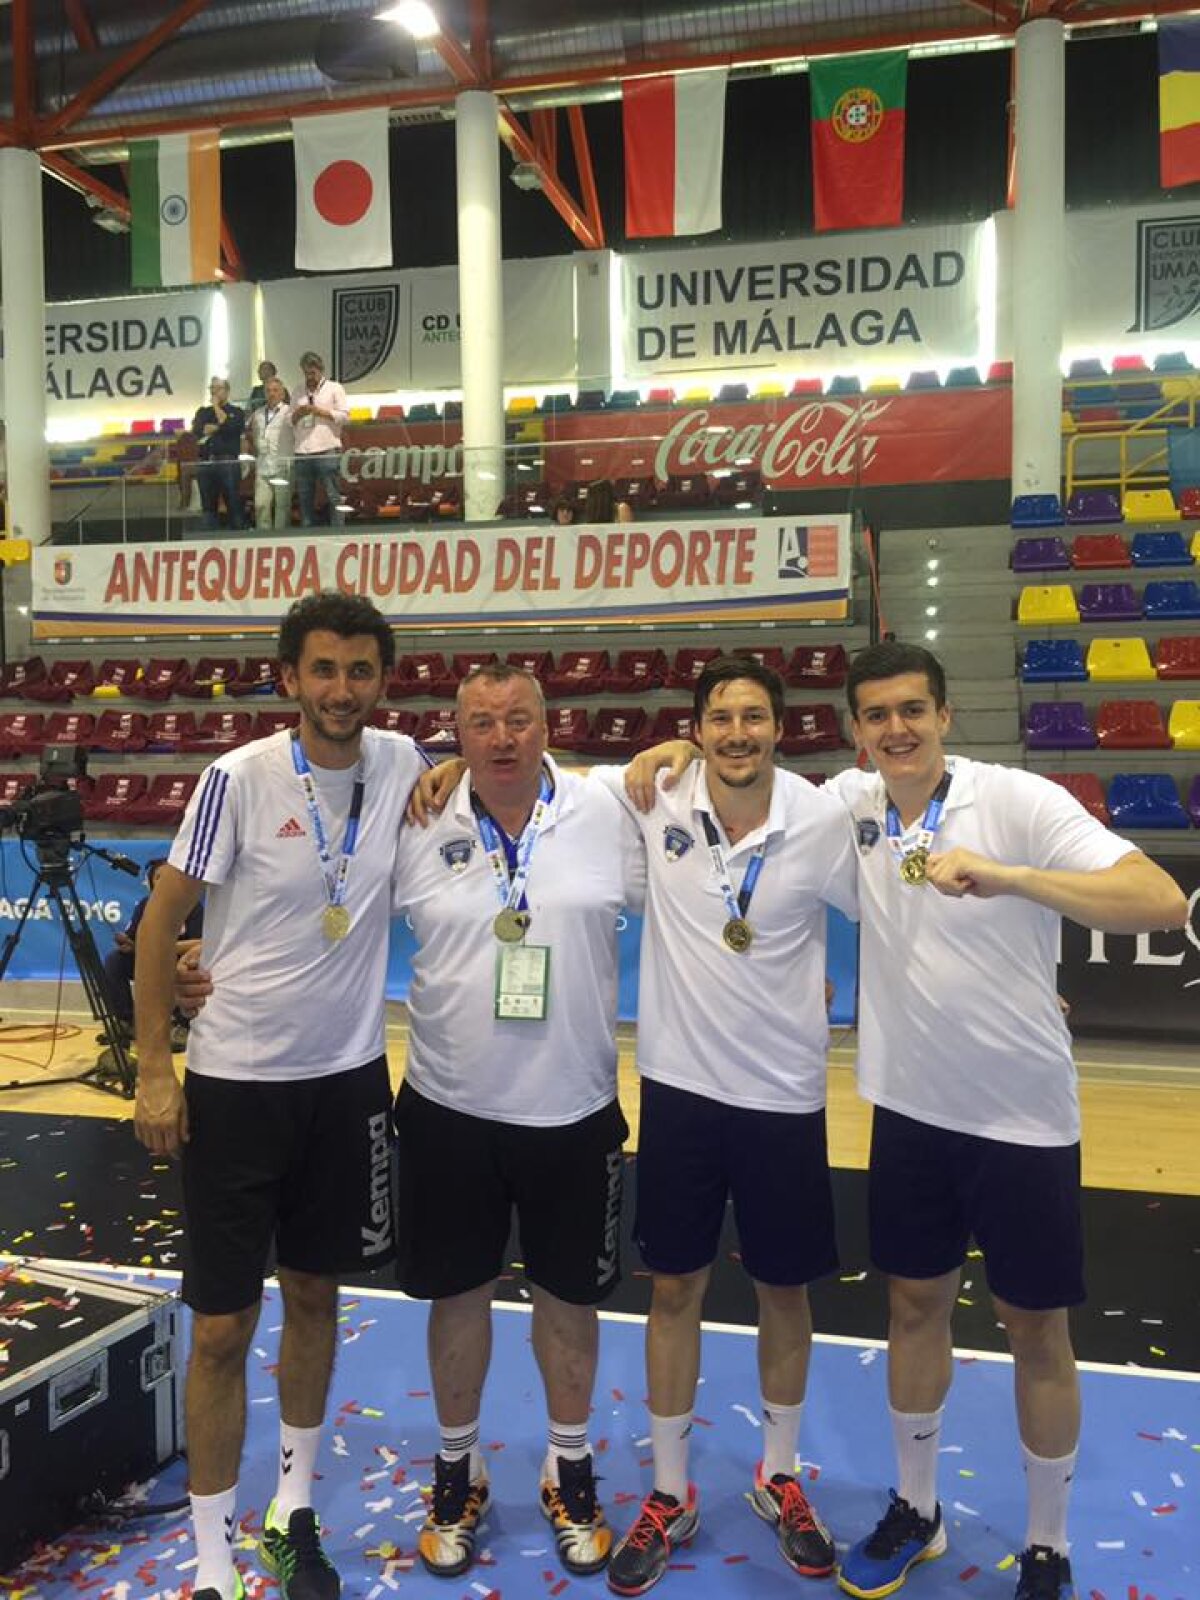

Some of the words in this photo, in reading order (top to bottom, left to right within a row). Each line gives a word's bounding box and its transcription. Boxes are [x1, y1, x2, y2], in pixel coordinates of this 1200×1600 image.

[1153, 230, 1200, 249] CLU
[637, 251, 965, 310] UNIVERSIDAD
[1151, 260, 1199, 280] UMA
[344, 298, 387, 314] CLUB
[422, 315, 451, 331] CD
[45, 315, 202, 356] ERSIDAD
[344, 325, 381, 341] UMA
[637, 323, 697, 361] DE
[713, 307, 922, 356] MÁLAGA
[46, 363, 174, 401] ÁLAGA
[654, 399, 893, 481] Coca-Cola
[104, 546, 321, 604] ANTEQUERA
[335, 539, 481, 596] CIUDAD
[494, 536, 561, 593] DEL
[574, 527, 757, 590] DEPORTE
[361, 1111, 392, 1257] Kempa
